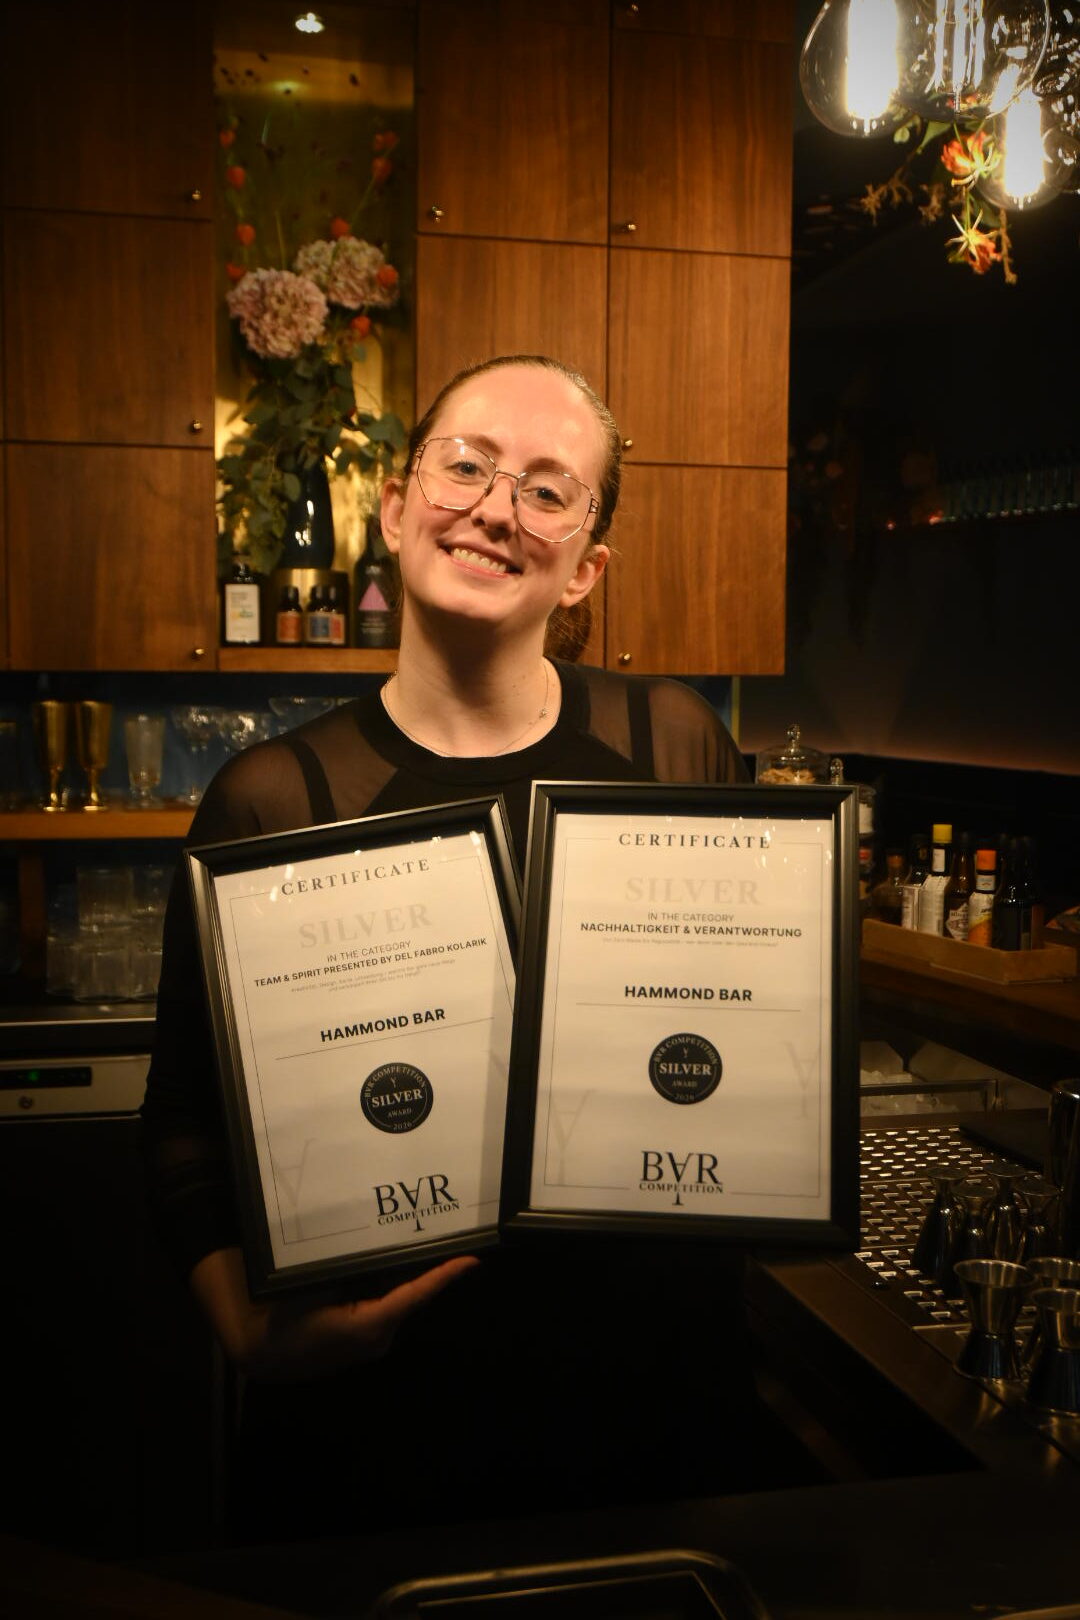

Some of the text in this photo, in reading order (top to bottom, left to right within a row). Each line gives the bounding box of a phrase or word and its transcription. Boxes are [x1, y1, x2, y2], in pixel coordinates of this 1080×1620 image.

[619, 833, 770, 848] CERTIFICATE
[281, 859, 430, 896] CERTIFICATE
[625, 877, 760, 905] SILVER
[299, 904, 433, 948] SILVER
[648, 913, 734, 922] IN THE CATEGORY
[581, 923, 802, 937] NACHHALTIGKEIT & VERANTWORTUNG
[327, 941, 411, 962] IN THE CATEGORY
[254, 975, 282, 987] TEAM
[284, 973, 290, 982] &
[292, 968, 321, 981] SPIRIT
[324, 958, 378, 975] PRESENTED
[380, 955, 392, 964] BY
[394, 952, 412, 962] DEL
[415, 946, 445, 958] FABRO
[447, 938, 487, 952] KOLARIK
[625, 986, 752, 1001] HAMMOND BAR
[321, 1008, 446, 1042] HAMMOND BAR
[373, 1066, 425, 1088] COMPETITION
[659, 1063, 711, 1075] SILVER
[372, 1089, 423, 1107] SILVER
[639, 1183, 724, 1194] COMPETITION
[378, 1202, 460, 1225] COMPETITION
